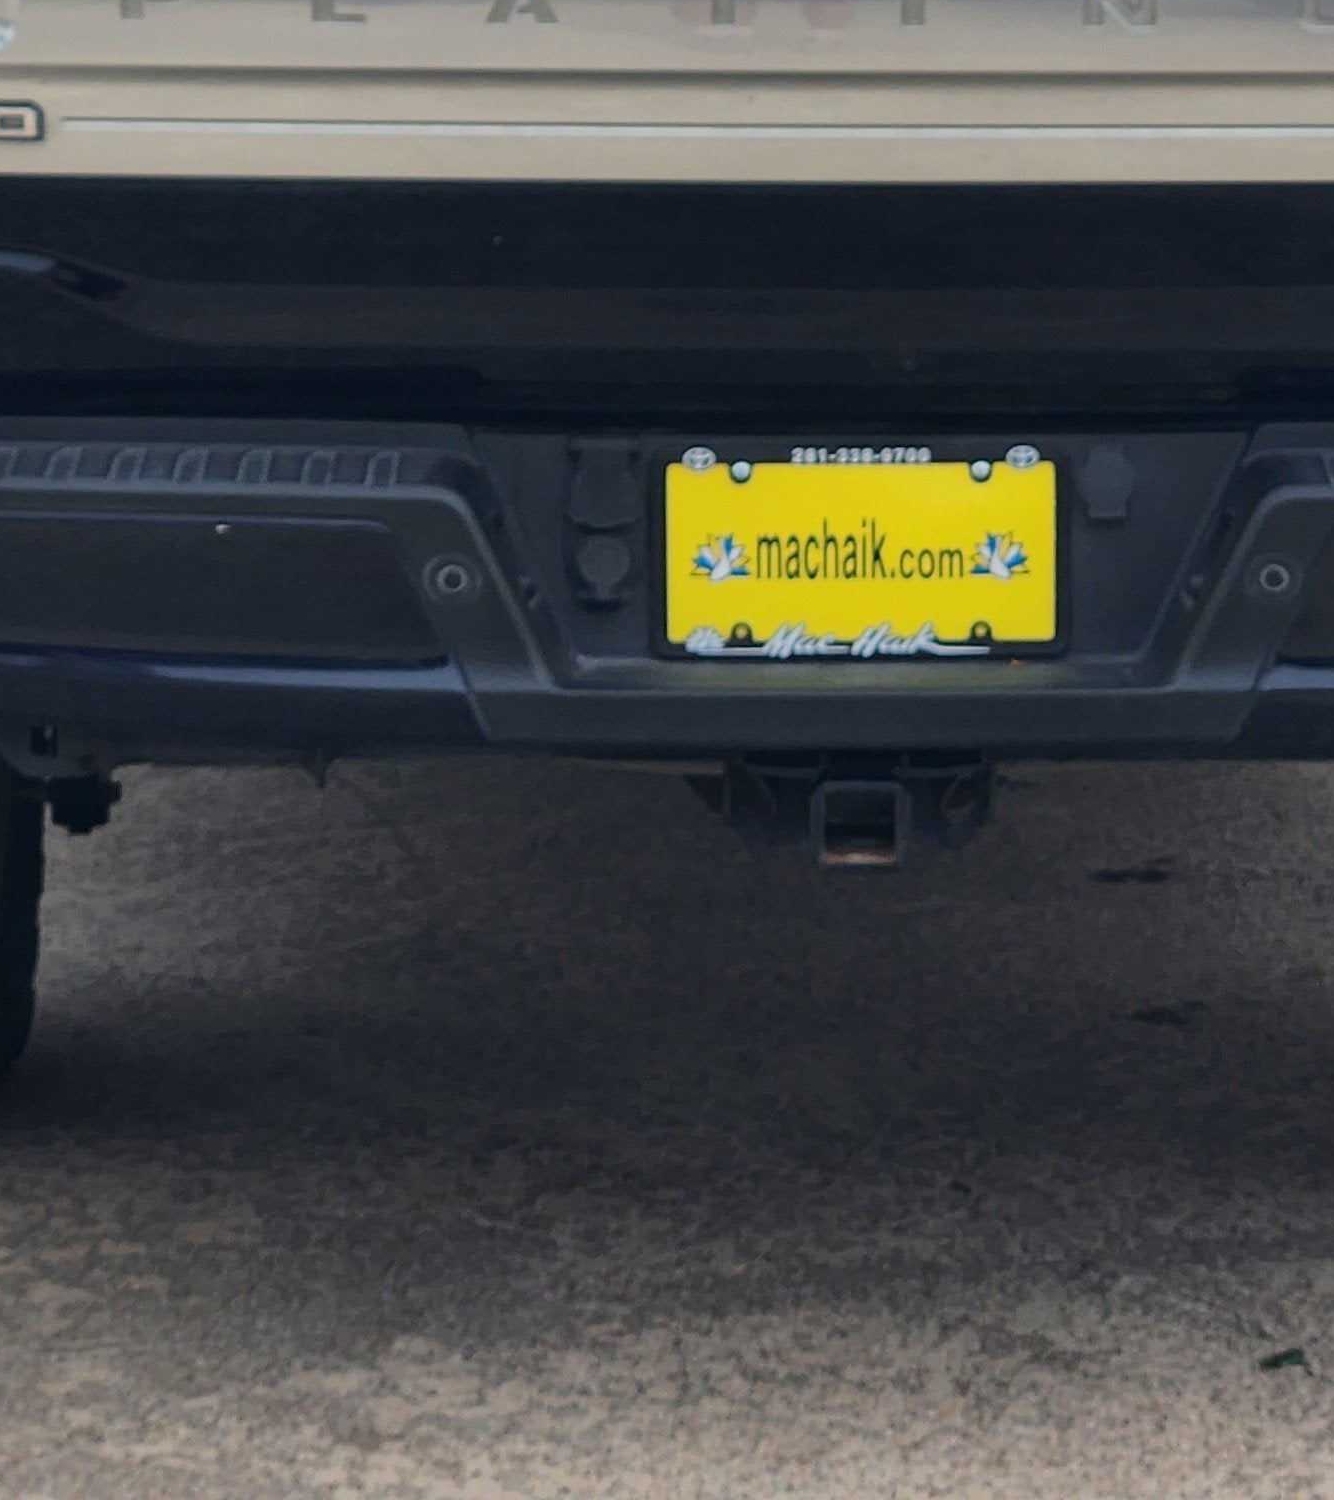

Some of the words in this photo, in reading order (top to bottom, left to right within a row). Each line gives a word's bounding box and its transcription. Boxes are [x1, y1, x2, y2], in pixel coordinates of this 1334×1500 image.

[756, 518, 964, 579] machaik.com
[764, 622, 843, 659] Mac
[850, 621, 944, 659] Haik
